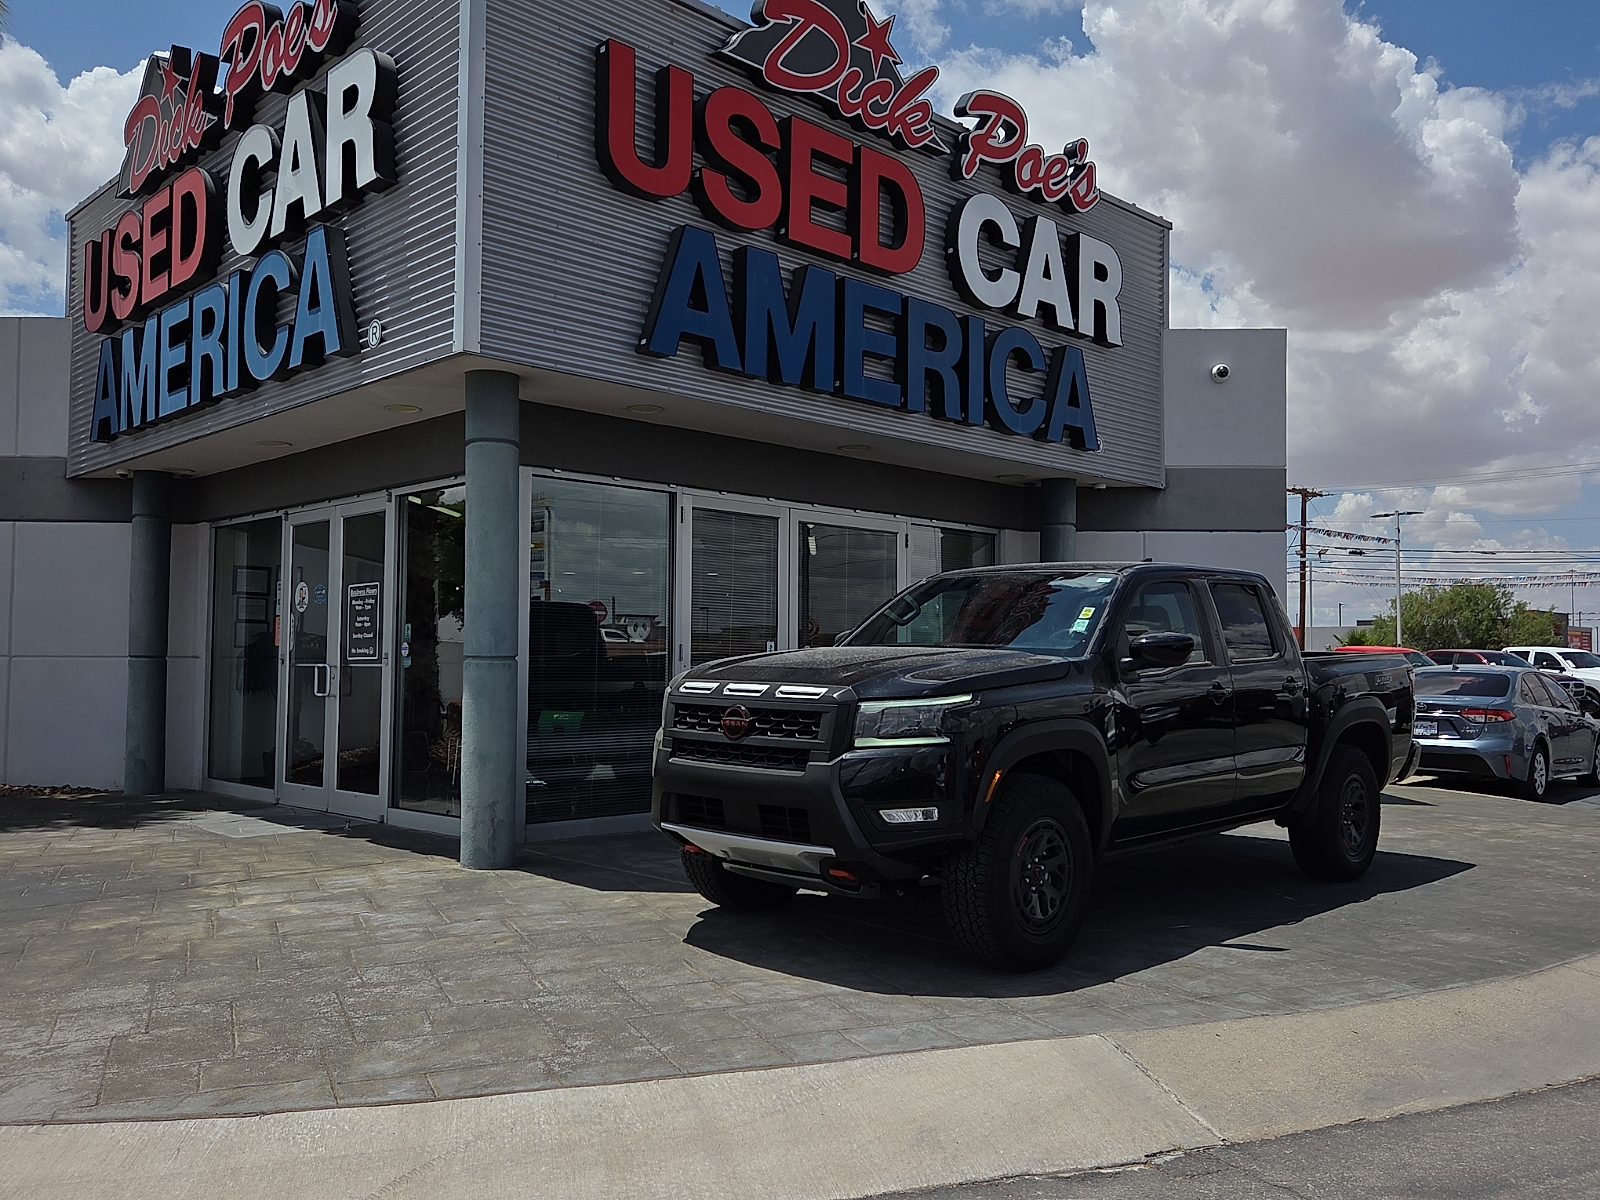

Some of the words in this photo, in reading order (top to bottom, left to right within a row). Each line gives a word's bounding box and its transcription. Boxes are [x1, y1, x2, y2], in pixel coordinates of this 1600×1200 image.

[84, 166, 208, 333] USED
[227, 48, 379, 256] CAR
[124, 51, 207, 195] Dick
[220, 0, 338, 130] Poes
[606, 38, 926, 276] USED
[957, 193, 1124, 348] CAR
[762, 0, 939, 148] Dick
[961, 89, 1100, 213] Poe's
[90, 225, 341, 442] AMERICA
[648, 224, 1099, 452] AMERICA
